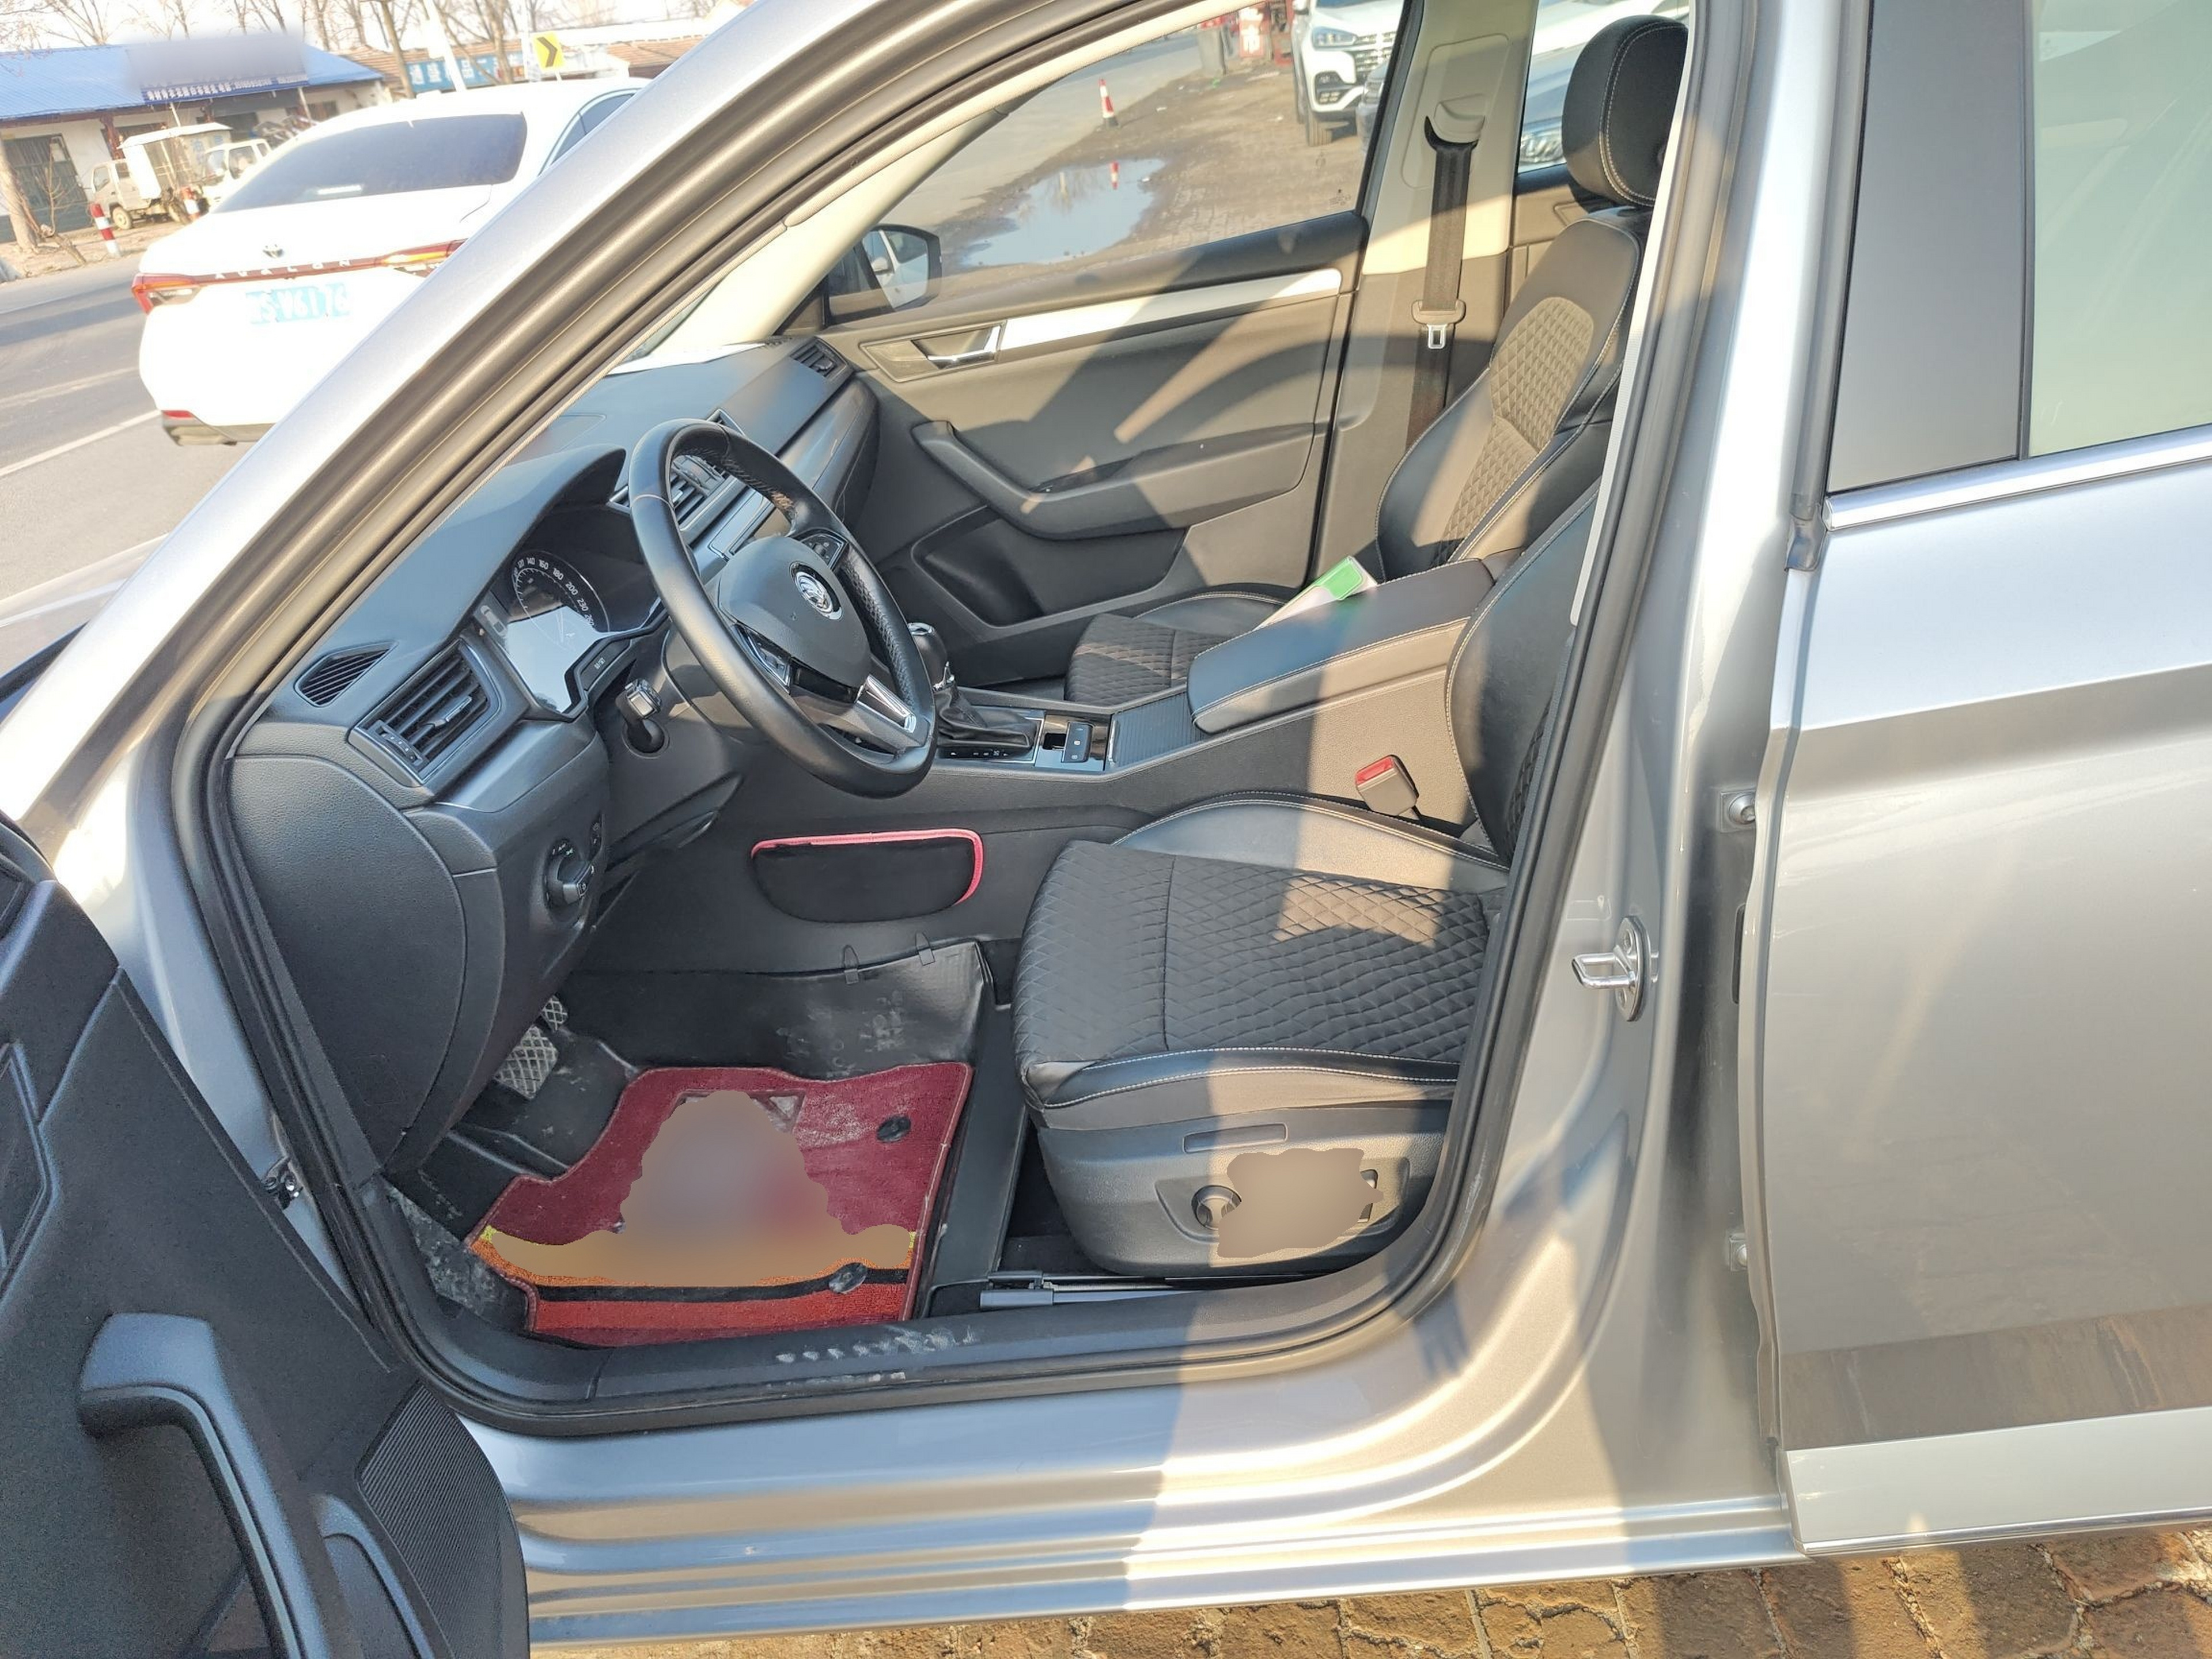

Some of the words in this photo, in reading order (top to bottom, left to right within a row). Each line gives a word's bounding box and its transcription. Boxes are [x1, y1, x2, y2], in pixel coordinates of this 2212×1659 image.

[526, 557, 536, 565] 140
[552, 568, 564, 581] 180
[565, 581, 578, 596] 200
[577, 597, 589, 612] 230
